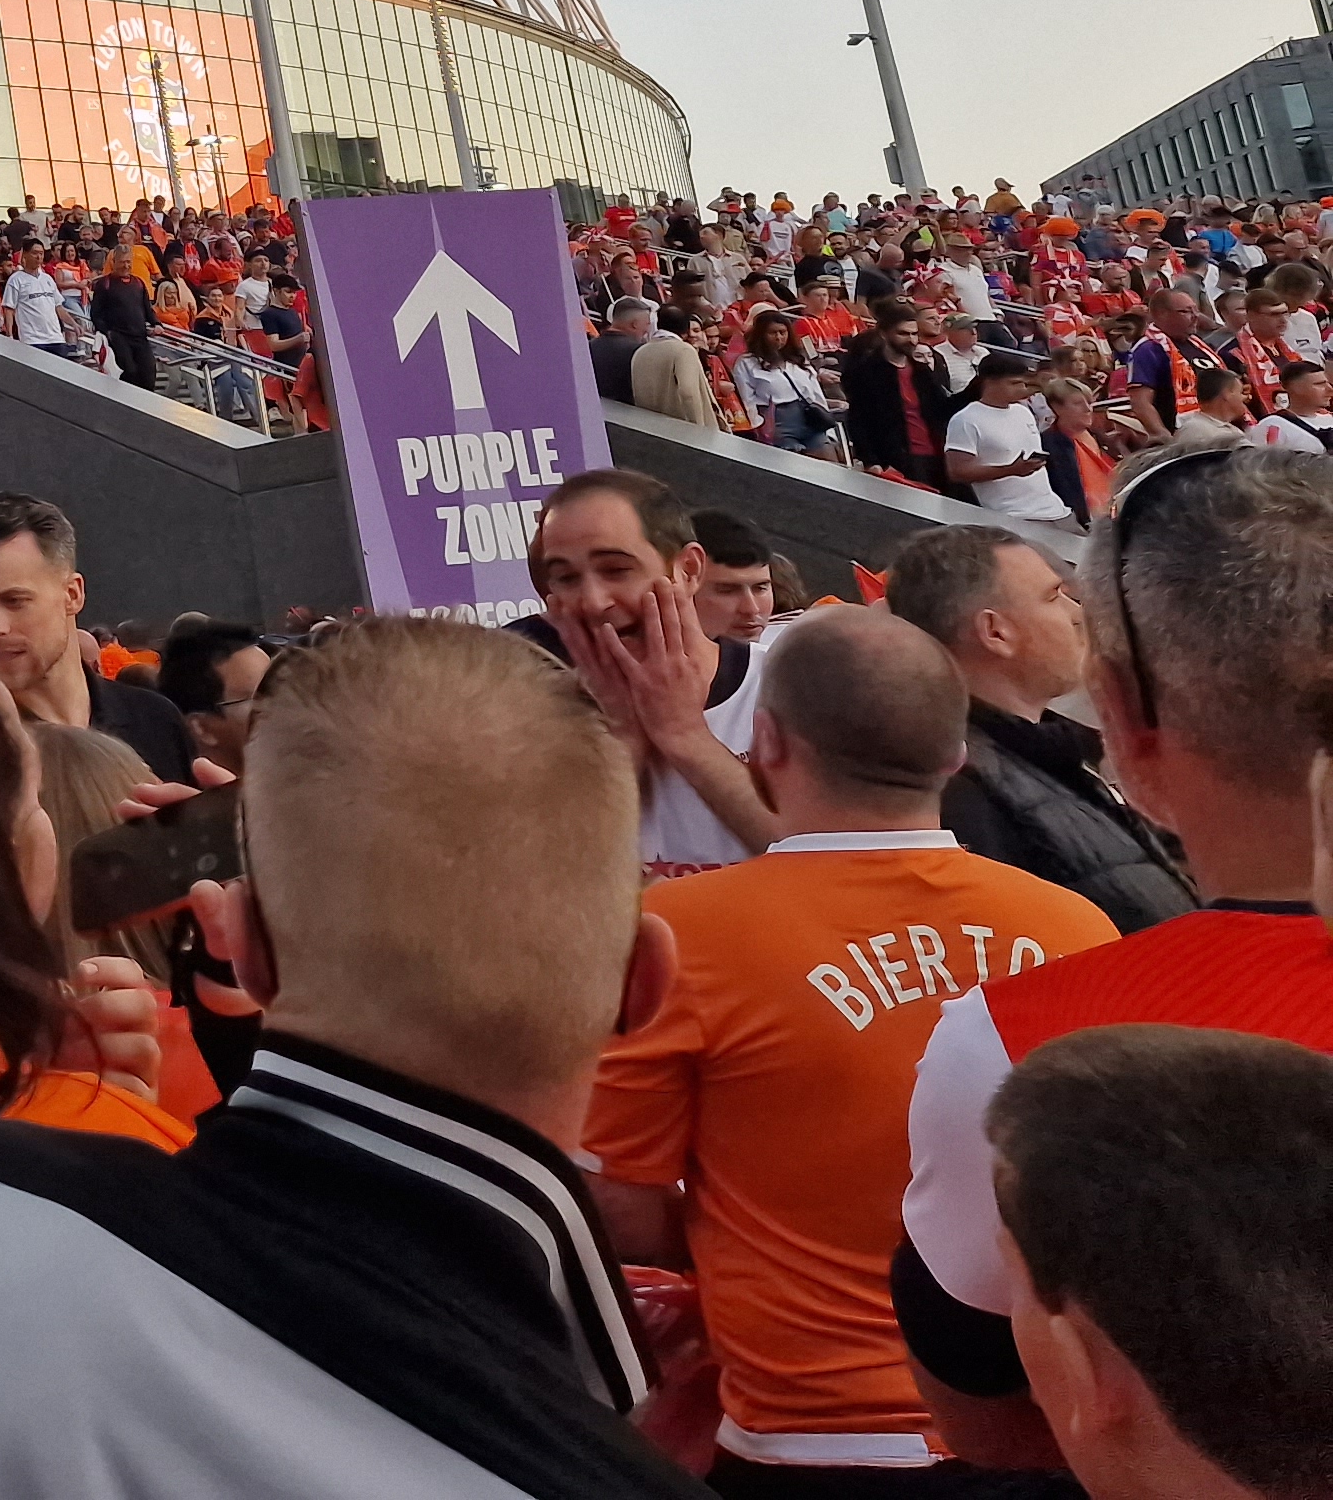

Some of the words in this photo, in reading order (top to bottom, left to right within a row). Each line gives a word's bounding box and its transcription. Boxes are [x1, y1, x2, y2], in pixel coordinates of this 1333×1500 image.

[90, 17, 146, 71] LUTON
[151, 19, 210, 80] TOWN
[397, 427, 563, 497] PURPLE
[806, 923, 1063, 1032] BIERTO
